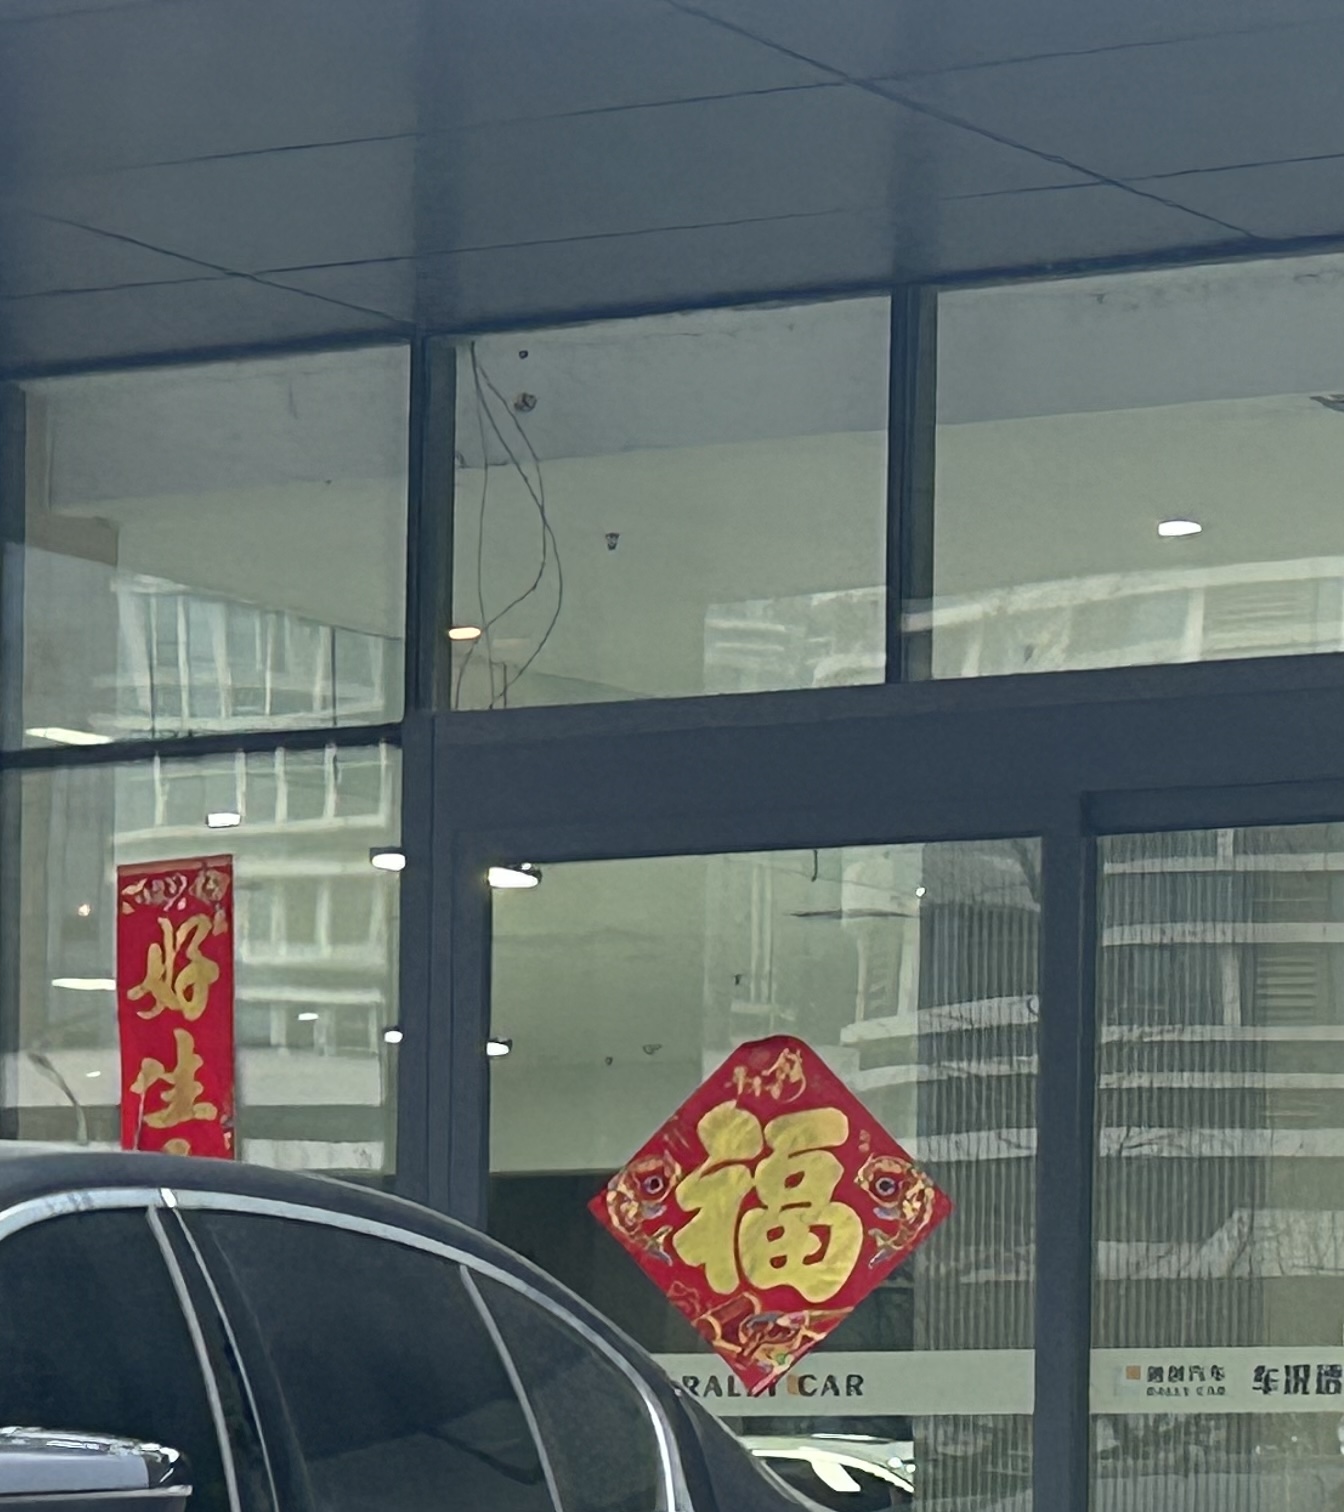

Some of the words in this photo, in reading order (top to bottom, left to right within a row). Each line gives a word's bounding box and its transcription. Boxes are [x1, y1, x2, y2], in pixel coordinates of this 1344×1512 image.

[126, 913, 220, 1156] 好生
[672, 1099, 863, 1303] 福
[798, 1374, 864, 1397] CAR
